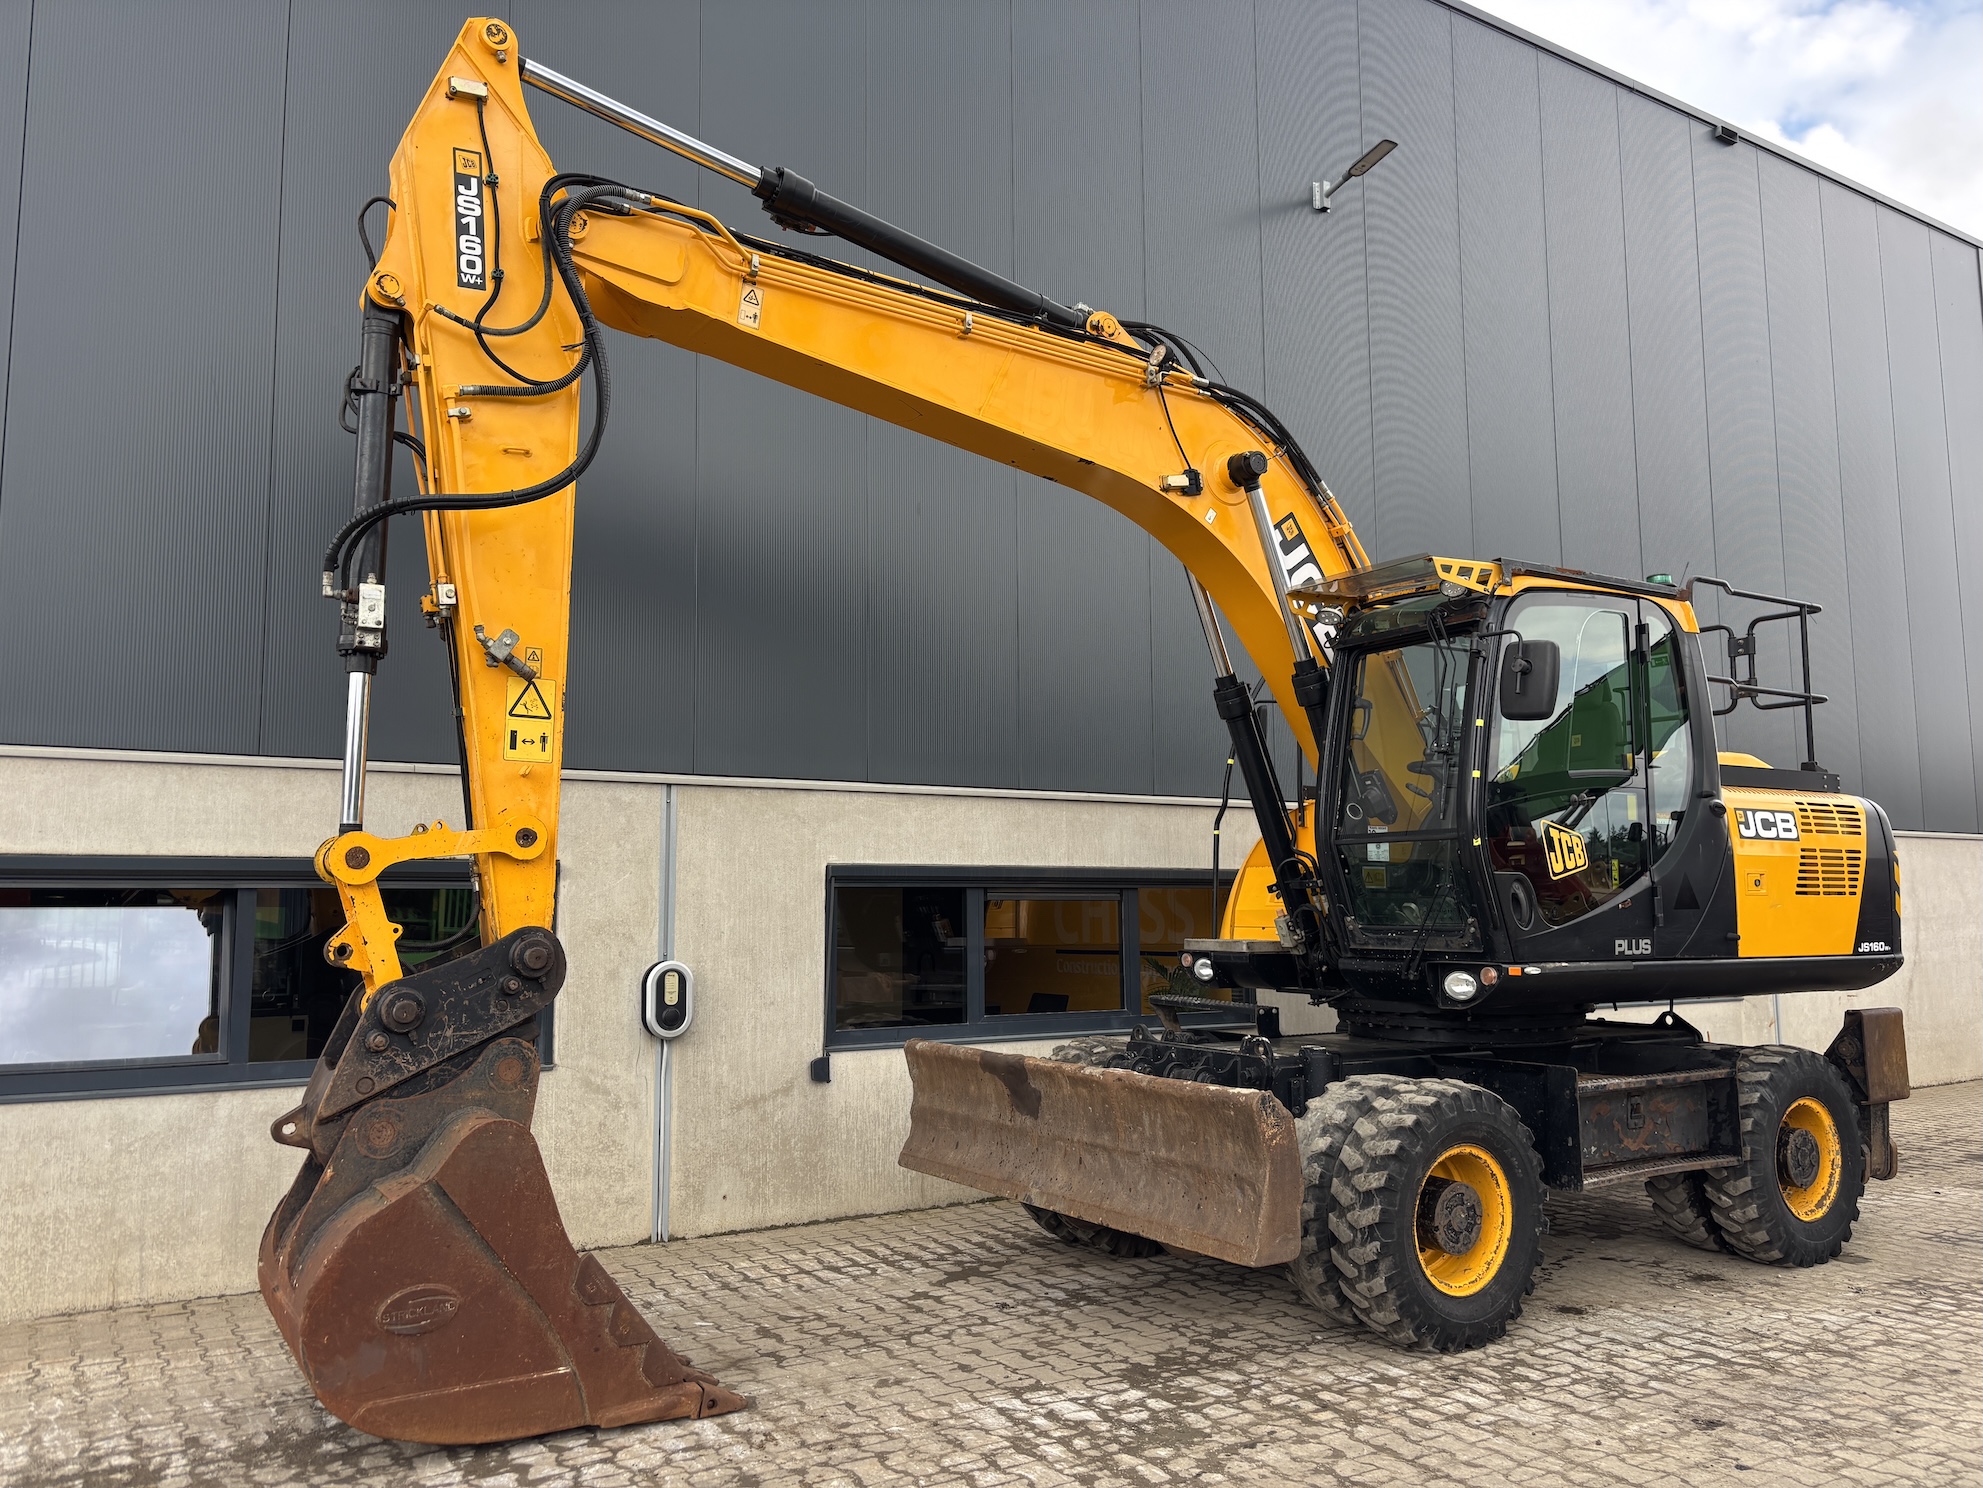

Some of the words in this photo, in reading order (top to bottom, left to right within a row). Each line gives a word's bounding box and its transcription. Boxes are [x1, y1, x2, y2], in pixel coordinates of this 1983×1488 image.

[1739, 810, 1798, 839] JCB
[1549, 827, 1585, 874] JCB
[1054, 888, 1194, 945] CHSS
[1614, 939, 1652, 956] PLUS
[1056, 958, 1119, 976] Constructio
